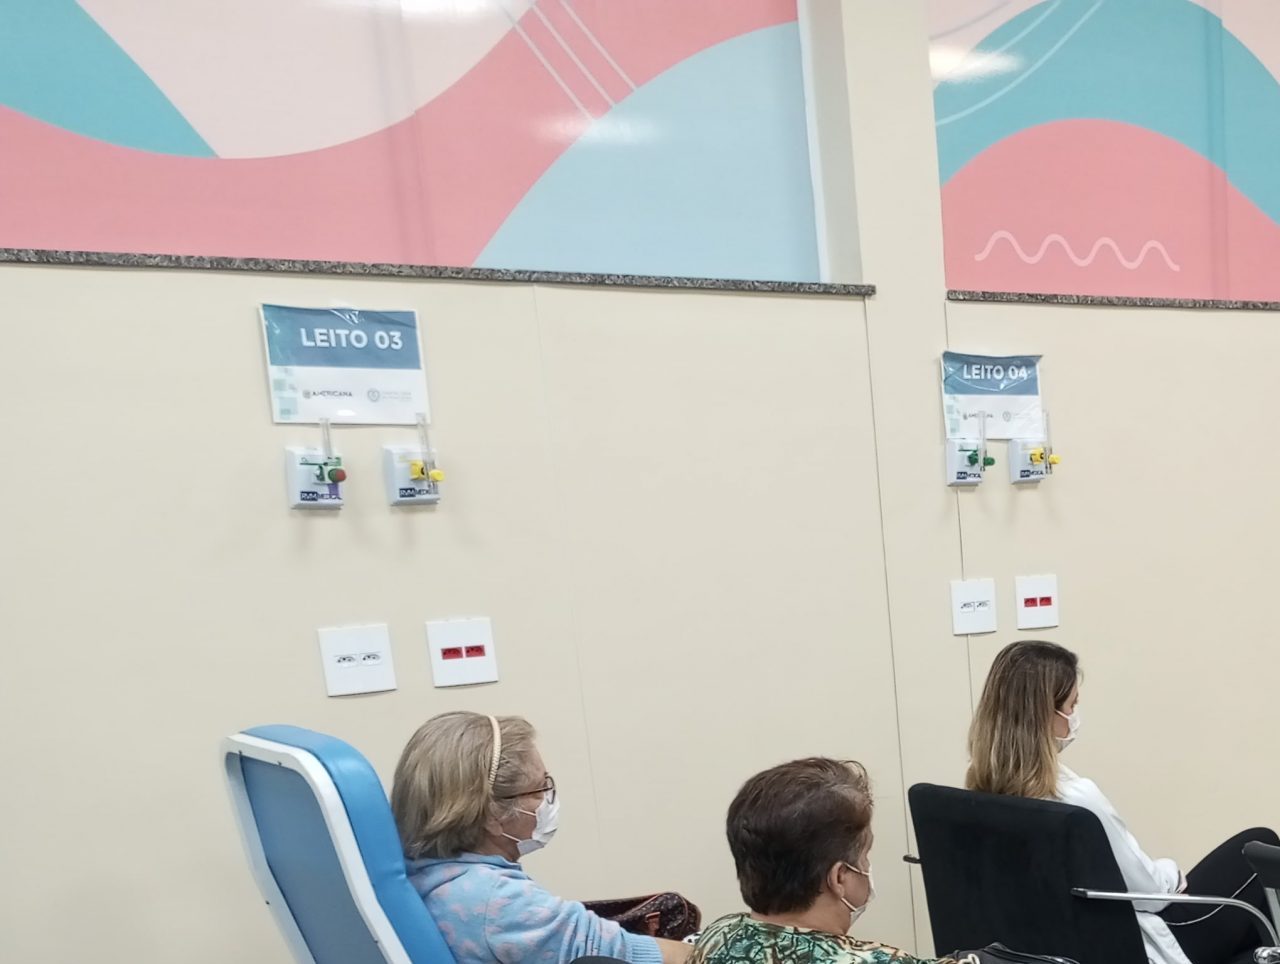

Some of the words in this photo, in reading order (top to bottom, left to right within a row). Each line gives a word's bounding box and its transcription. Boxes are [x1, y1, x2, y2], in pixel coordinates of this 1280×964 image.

[300, 327, 368, 348] LEITO
[374, 330, 403, 349] 03
[963, 364, 1004, 380] LEITO
[1008, 365, 1028, 381] 04
